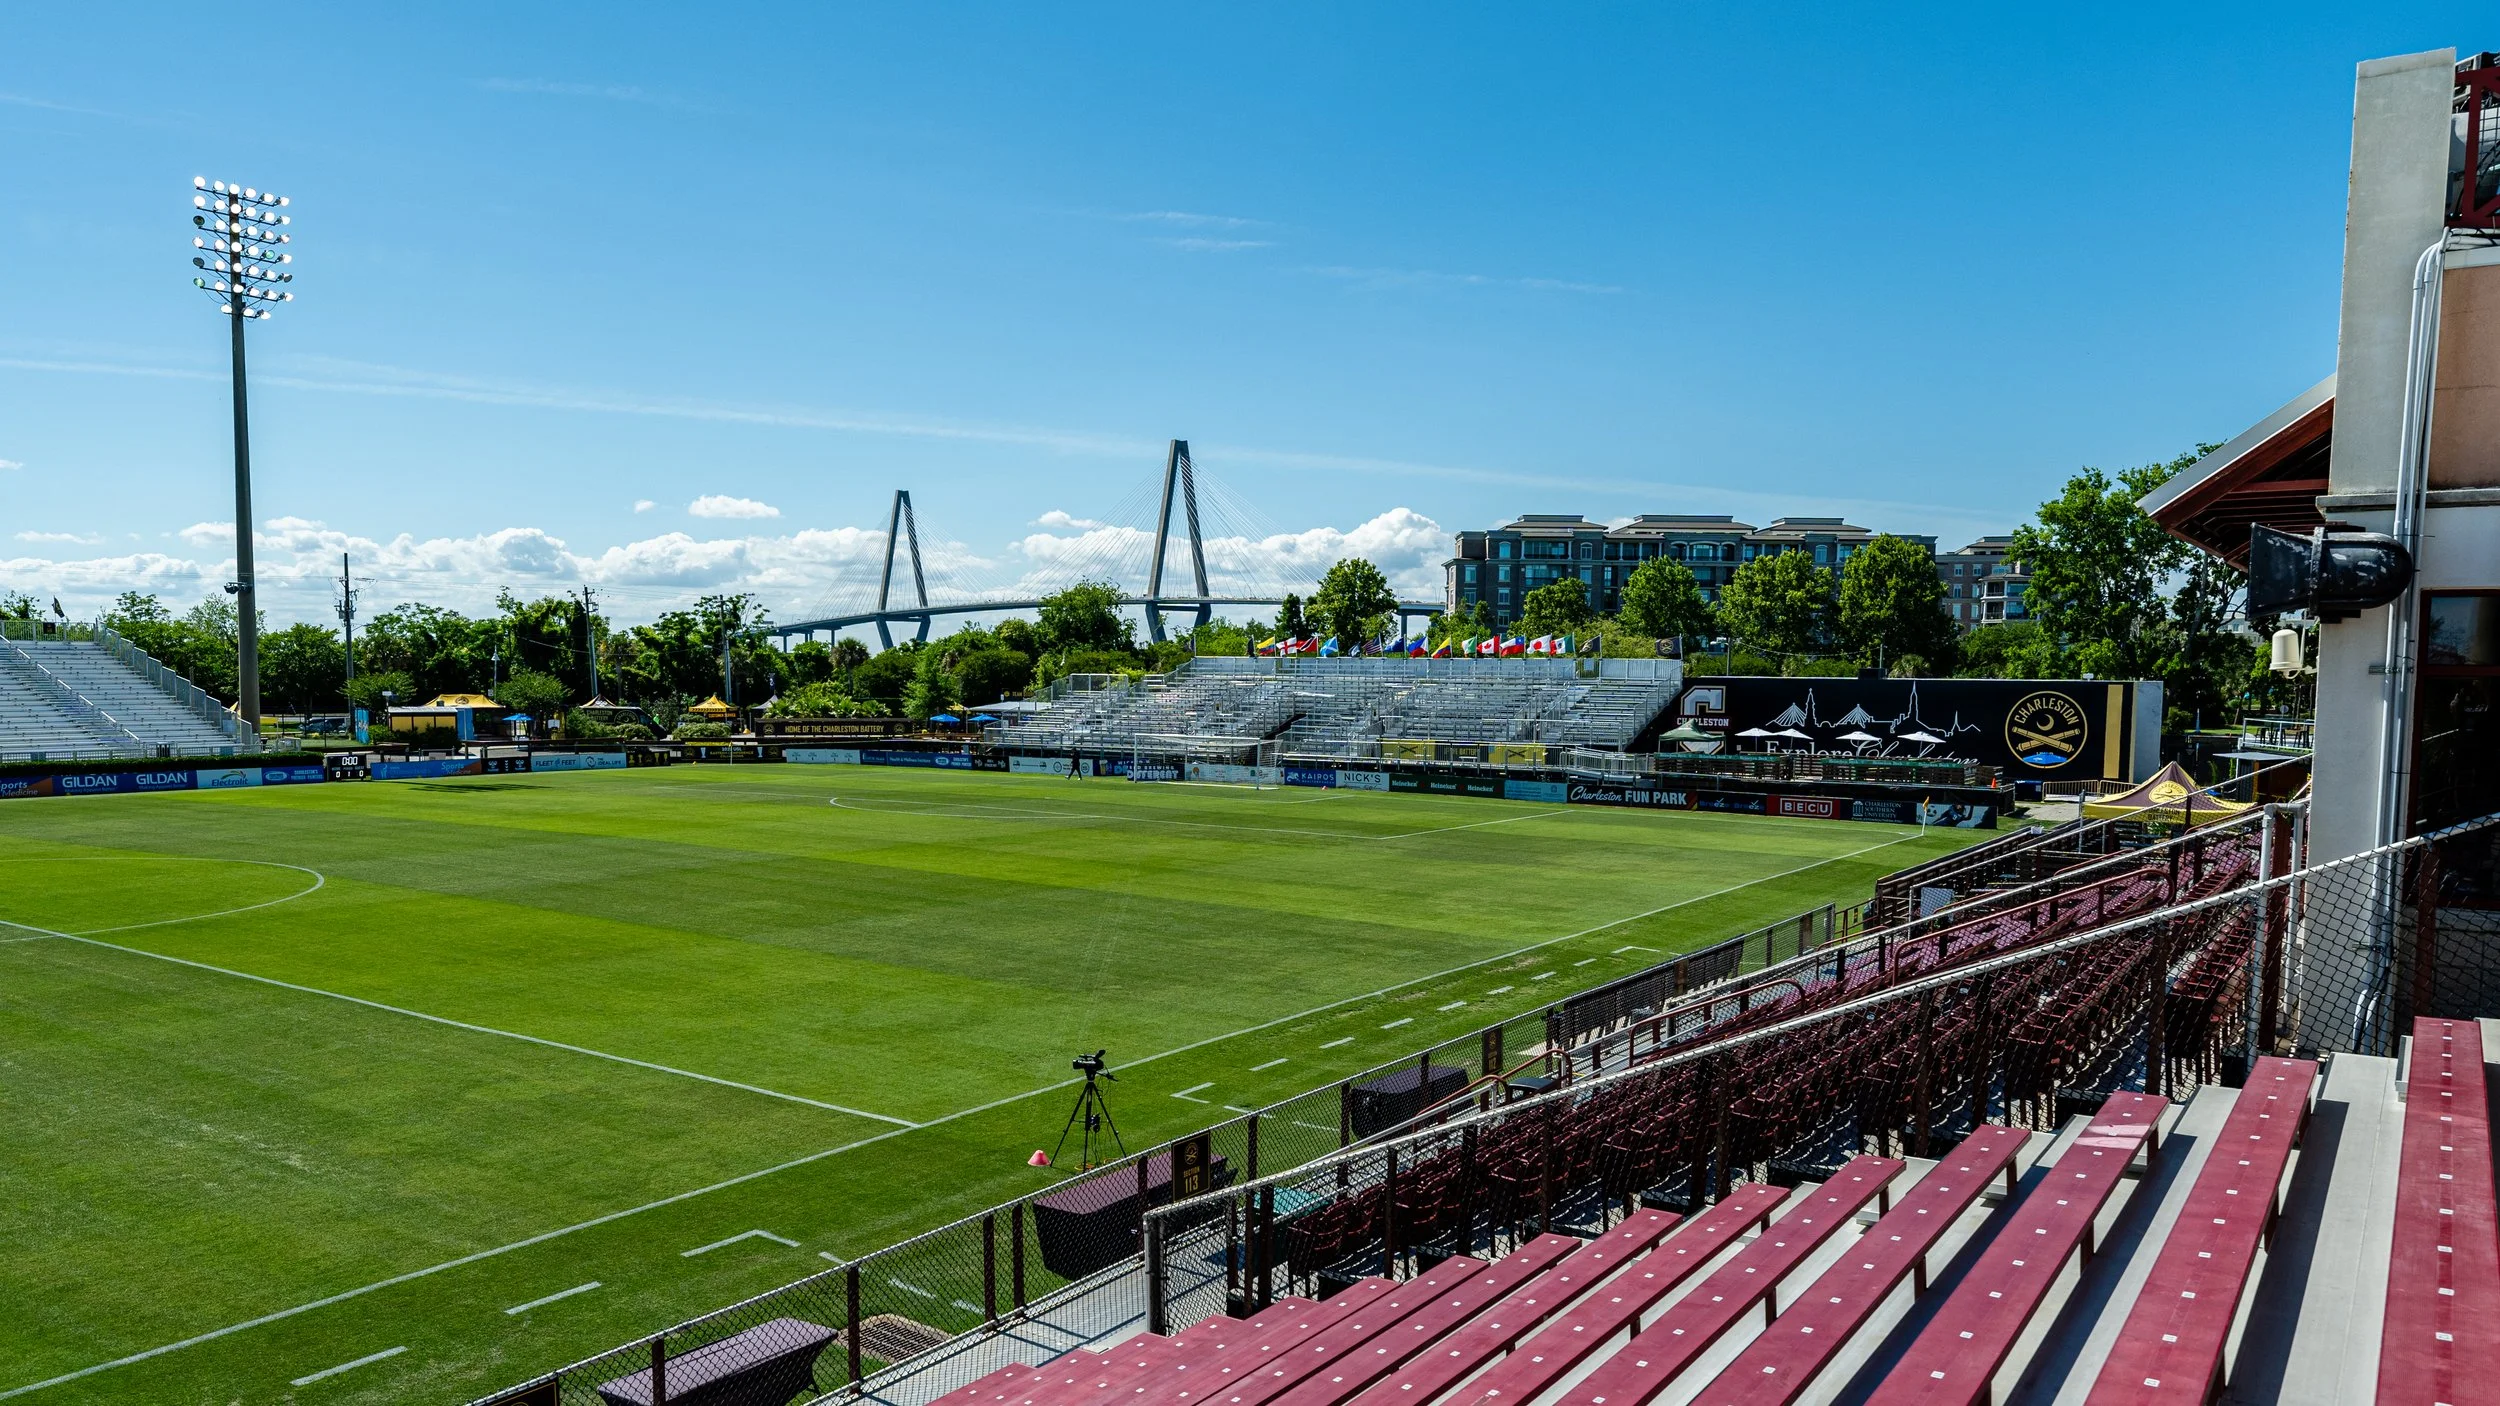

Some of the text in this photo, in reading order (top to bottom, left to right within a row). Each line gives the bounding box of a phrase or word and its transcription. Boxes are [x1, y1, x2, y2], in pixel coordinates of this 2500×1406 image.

[2014, 696, 2080, 726] CHARLESTON
[784, 725, 884, 733] HOME OF THE CHARLESTON BATTERY
[341, 756, 359, 766] 0:00
[441, 761, 465, 773] Sports
[62, 772, 188, 788] GILDAN GILDAN
[211, 777, 249, 787] Electrolit
[1301, 773, 1335, 781] KAIROS
[1344, 772, 1382, 783] NICK'S
[0, 781, 28, 791] ports
[1391, 779, 1418, 788] Heineken
[1430, 782, 1457, 790] Heineken
[1467, 784, 1494, 792] Heineken
[2, 788, 39, 798] Medicine
[1570, 785, 1622, 802] Charleston
[1625, 790, 1651, 803] FUN
[1652, 790, 1687, 806] PARK
[1864, 811, 1897, 819] UNIVERSITY
[1183, 1166, 1200, 1178] SECTION
[1185, 1174, 1199, 1194] 113
